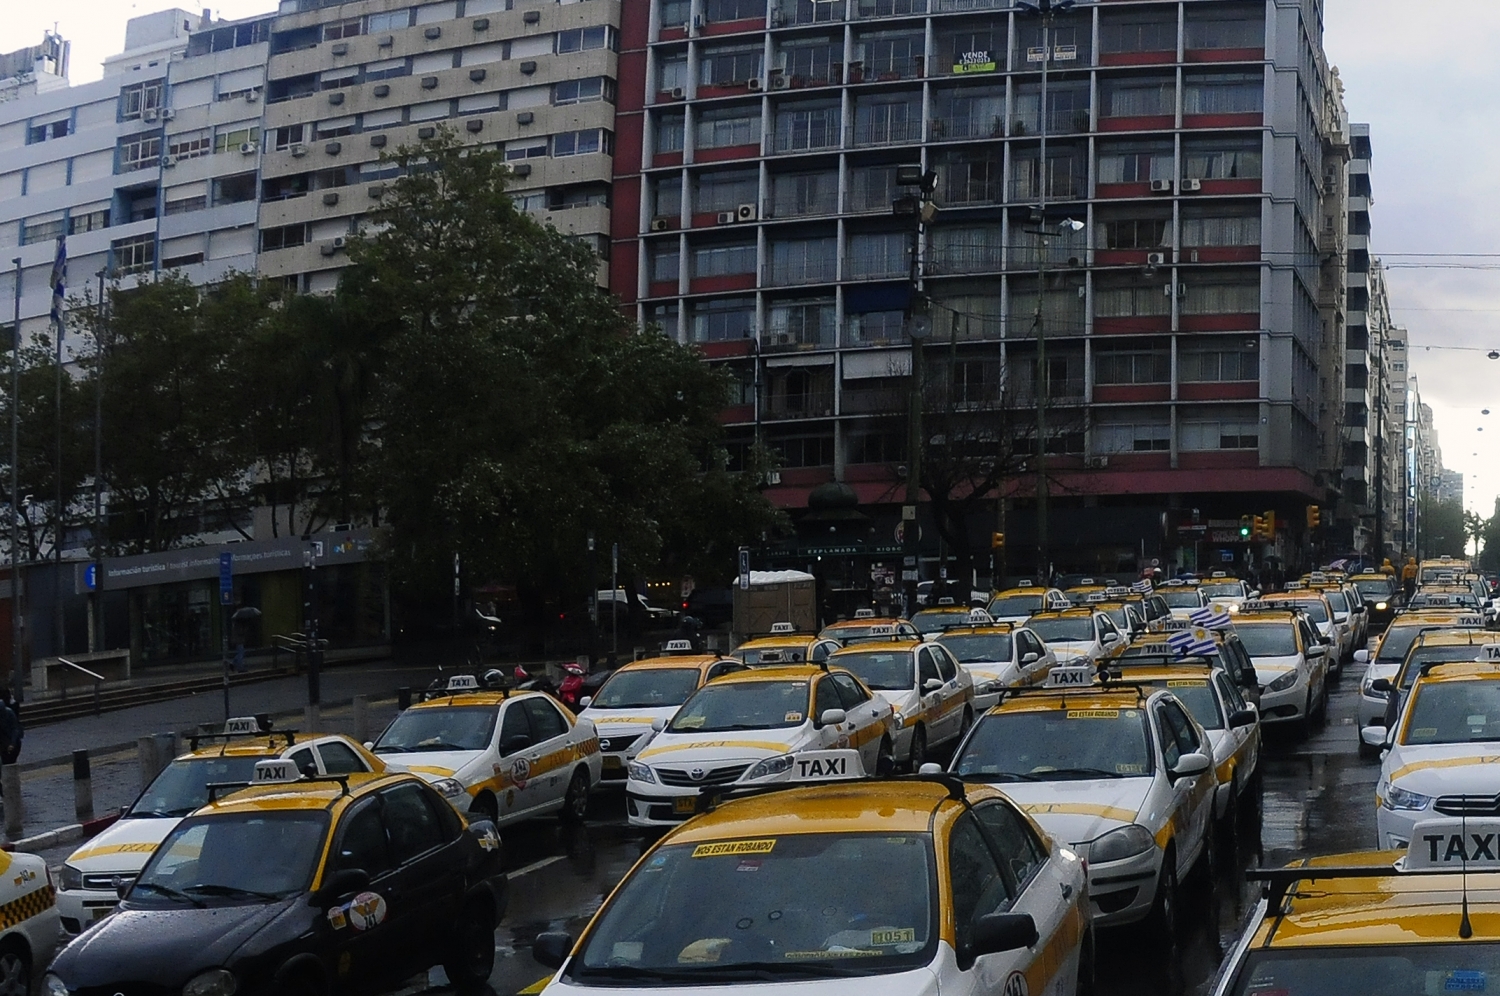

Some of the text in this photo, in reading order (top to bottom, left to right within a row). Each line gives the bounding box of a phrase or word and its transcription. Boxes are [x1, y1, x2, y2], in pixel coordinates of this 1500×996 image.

[1460, 617, 1482, 625] TAXI
[872, 626, 890, 634] TAXI
[669, 641, 687, 649] TAXI
[1146, 645, 1167, 653] TAXI
[1052, 672, 1083, 684] TAXI
[451, 679, 470, 687] TAXI
[228, 722, 250, 731] TAXI
[798, 757, 846, 777] TAXI
[257, 767, 286, 780] TAXI
[695, 841, 773, 855] NOS ESTAN ROBANDO
